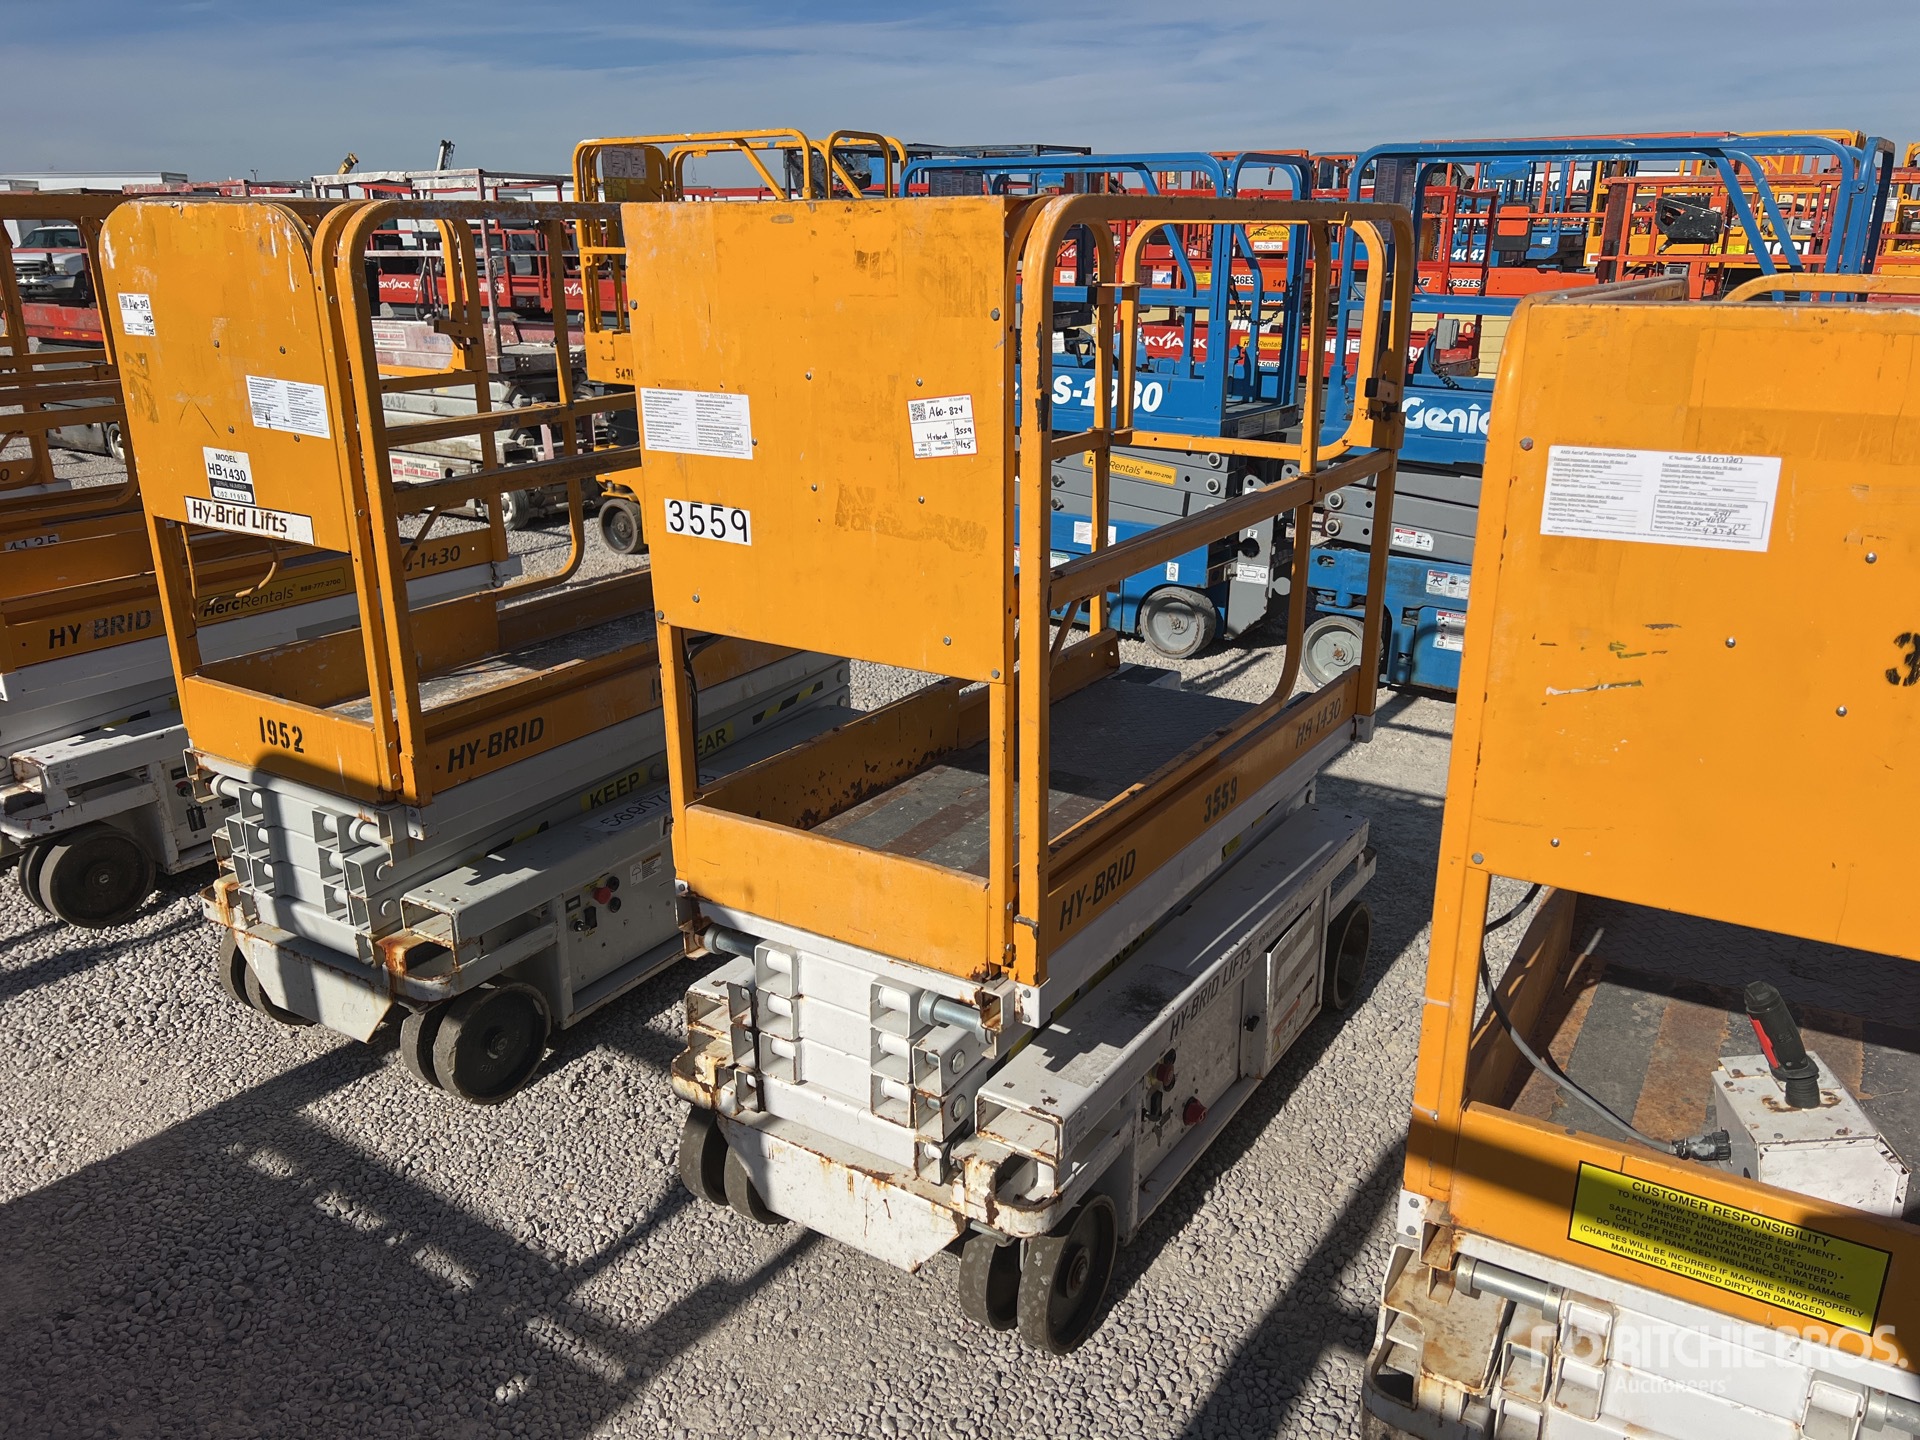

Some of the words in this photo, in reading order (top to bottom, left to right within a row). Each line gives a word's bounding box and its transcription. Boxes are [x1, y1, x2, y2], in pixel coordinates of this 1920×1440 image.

[378, 278, 411, 291] SKYJACK
[207, 462, 247, 482] HB1430
[215, 453, 238, 464] MODEL
[229, 482, 247, 490] NUMBER
[192, 500, 246, 527] Hy-Brid
[252, 509, 287, 533] Lifts
[668, 500, 749, 543] 3559
[203, 587, 294, 617] HercRentals
[259, 716, 304, 754] 1952
[447, 717, 545, 773] HY-BRID
[589, 771, 640, 810] KEEP
[1204, 776, 1239, 824] 3559
[1059, 848, 1137, 933] HY-BRID
[1170, 977, 1220, 1042] HY-BRID
[1222, 942, 1252, 988] LIFTS
[1608, 1203, 1645, 1220] SAFETY
[1646, 1214, 1692, 1234] HARNESS
[1692, 1229, 1714, 1241] AND
[1715, 1236, 1762, 1256] LANYARD
[1617, 1189, 1630, 1199] TO
[1631, 1193, 1661, 1208] KNOW
[1662, 1203, 1686, 1216] HOW
[1686, 1209, 1699, 1220] TO
[1701, 1214, 1753, 1236] PROPERLY
[1754, 1230, 1775, 1243] USE
[1776, 1237, 1836, 1261] EQUIPMENT
[1631, 1181, 1709, 1212] CUSTOMER
[1712, 1205, 1831, 1248] RESPONSIBILITY
[1650, 1207, 1696, 1227] PREVENT
[1696, 1221, 1773, 1251] UNAUTHORIZED
[1774, 1245, 1795, 1258] USE
[1596, 1216, 1610, 1227] DO
[1611, 1221, 1631, 1233] NOT
[1632, 1227, 1652, 1240] USE
[1653, 1234, 1663, 1242] IF
[1664, 1238, 1712, 1258] DAMAGED
[1719, 1255, 1776, 1279] INSURANCE
[1783, 1275, 1806, 1288] TIRE
[1807, 1282, 1851, 1302] DAMAGE
[1615, 1213, 1639, 1227] CALL
[1640, 1221, 1661, 1232] OFF
[1661, 1227, 1688, 1242] RENT
[1694, 1238, 1741, 1258] MAINTAIN
[1792, 1268, 1828, 1285] WATER
[1628, 1239, 1650, 1252] WILL
[1653, 1246, 1666, 1257] BE
[1667, 1251, 1718, 1273] INCURRED
[1719, 1267, 1728, 1276] IF
[1729, 1271, 1775, 1291] MACHINE
[1776, 1285, 1786, 1295] IS
[1788, 1289, 1809, 1301] NOT
[1810, 1296, 1865, 1318] PROPERLY
[1670, 1261, 1723, 1284] RETURNED
[1756, 1289, 1771, 1300] OR
